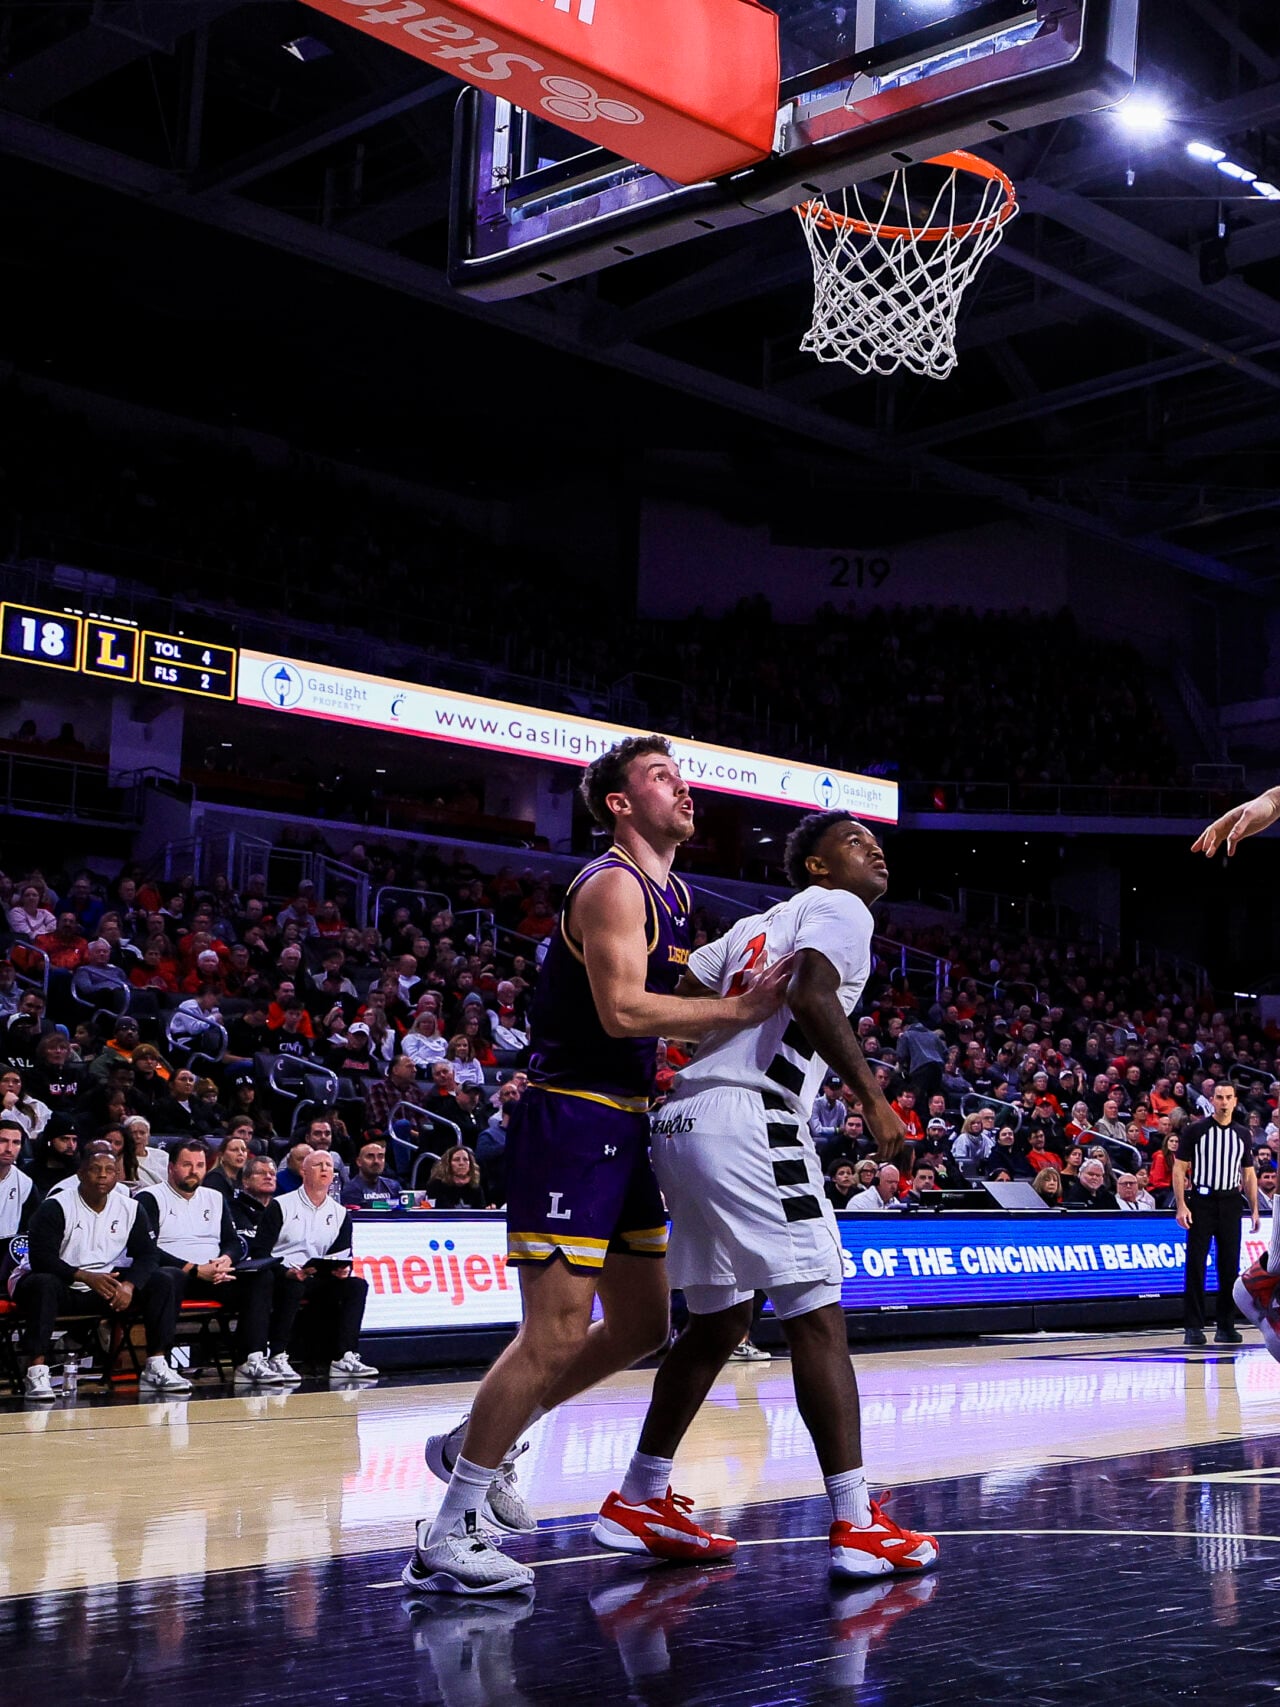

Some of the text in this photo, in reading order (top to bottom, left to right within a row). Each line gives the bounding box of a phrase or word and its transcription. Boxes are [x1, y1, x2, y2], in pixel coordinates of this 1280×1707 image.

[829, 556, 891, 588] 219
[21, 617, 65, 656] 18
[97, 631, 126, 669] L
[155, 641, 212, 665] TOL 4
[155, 666, 210, 689] FLS 2
[308, 678, 369, 701] Gaslight
[312, 696, 361, 711] PROPERTY
[843, 784, 882, 802] Gaslight
[547, 1192, 572, 1220] L
[352, 1239, 512, 1306] meijer
[862, 1247, 899, 1277] OF
[901, 1247, 957, 1276] THE
[960, 1244, 1099, 1276] CINCINNATI
